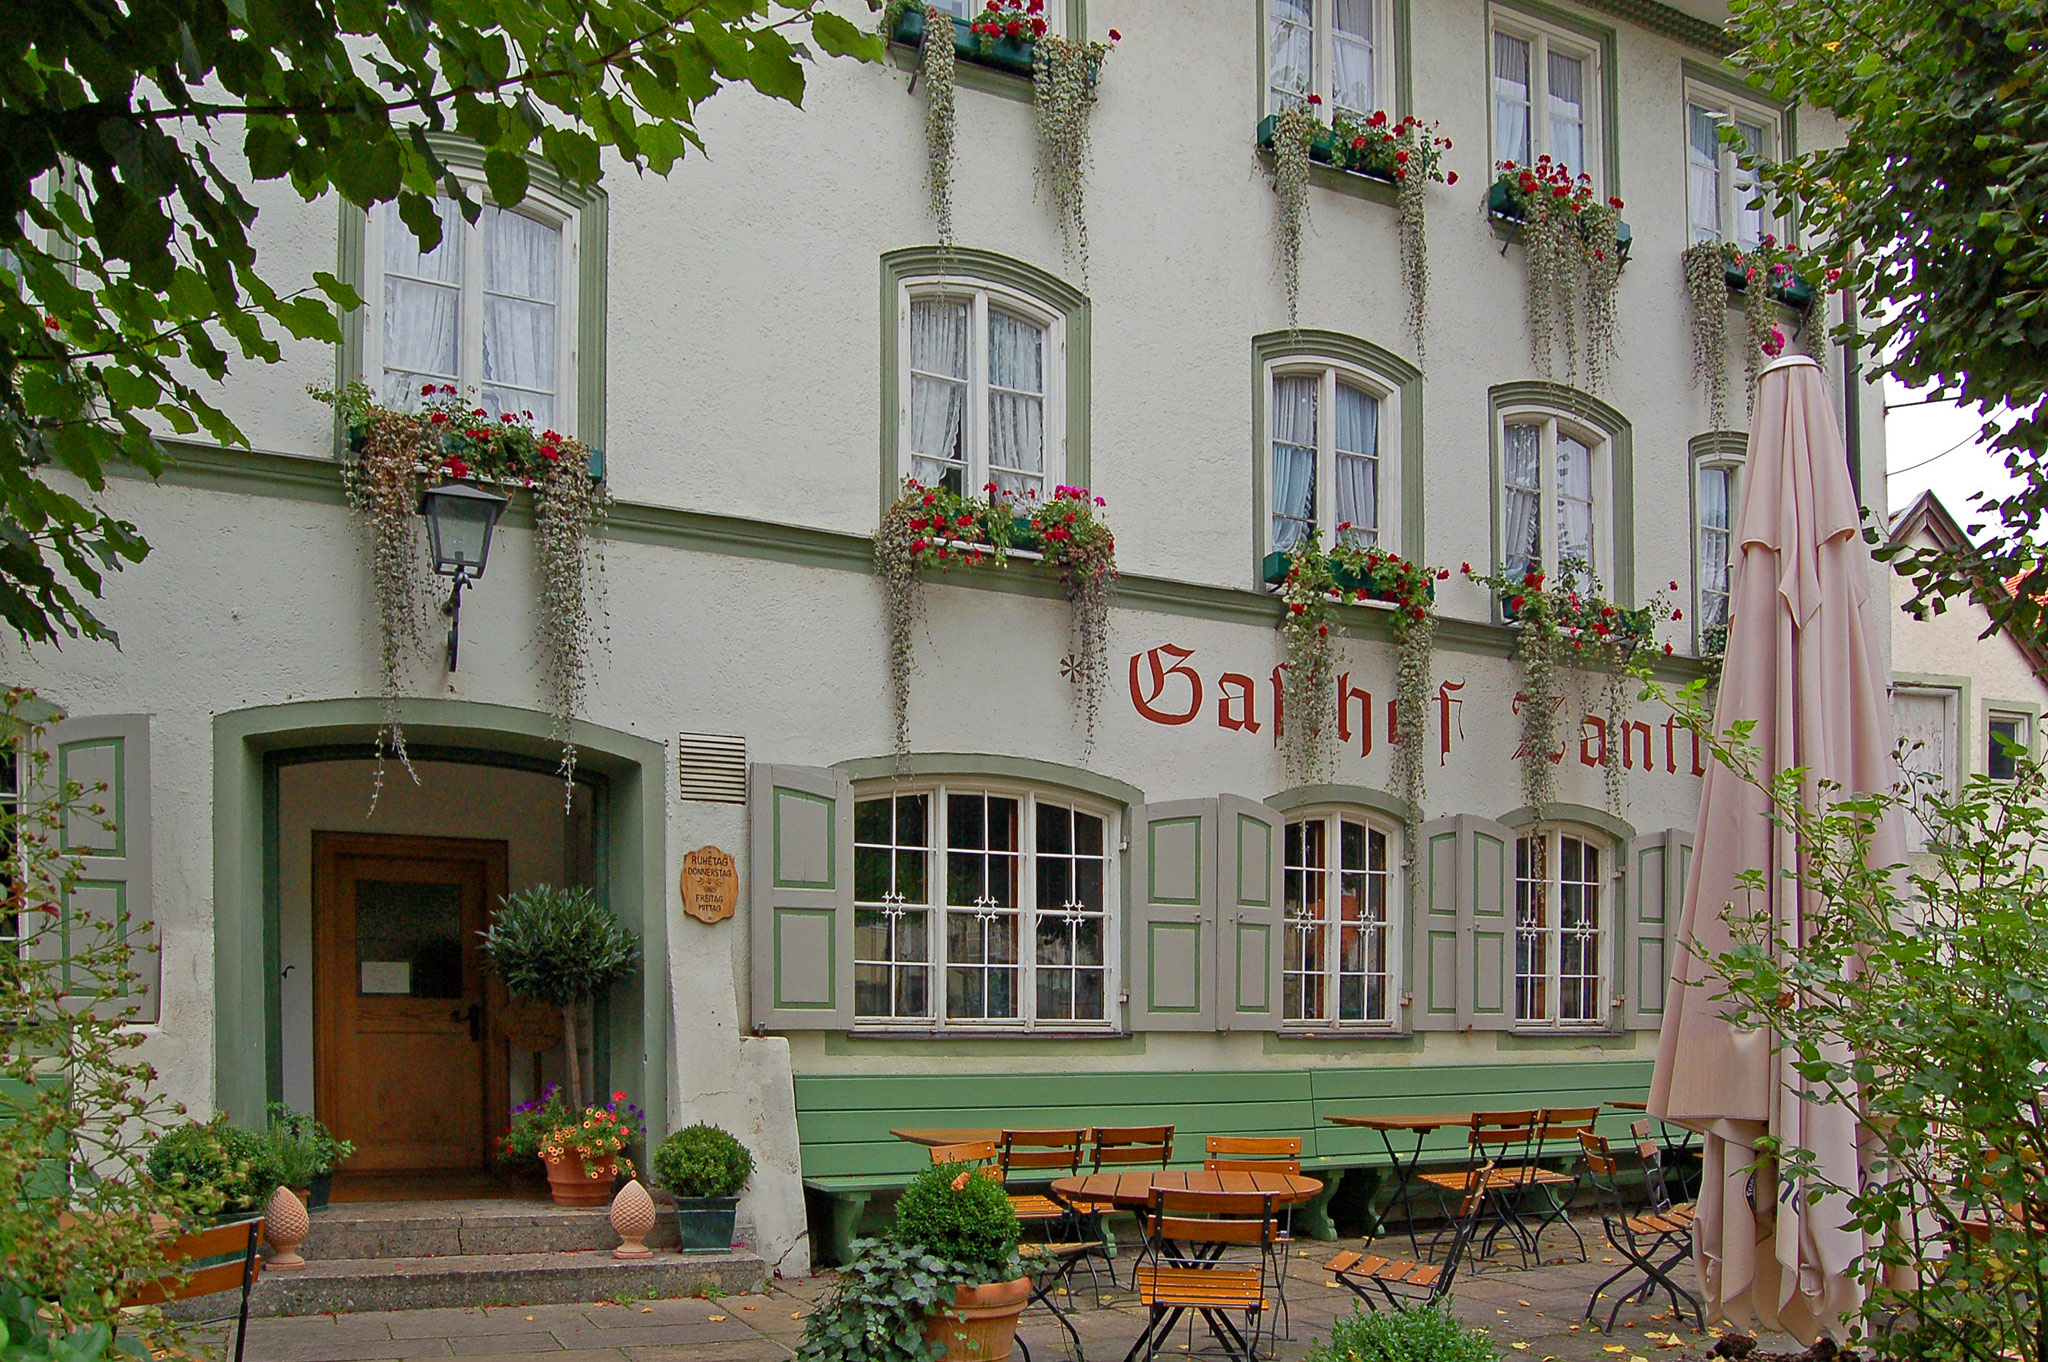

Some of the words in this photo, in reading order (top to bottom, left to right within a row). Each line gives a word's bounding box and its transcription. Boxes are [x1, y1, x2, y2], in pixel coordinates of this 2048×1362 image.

[1128, 643, 1465, 767] Gashf
[692, 856, 728, 866] RUHETAG
[687, 867, 732, 878] DONNERSTAG
[695, 894, 723, 903] FREITAG
[698, 904, 721, 912] MITTAG
